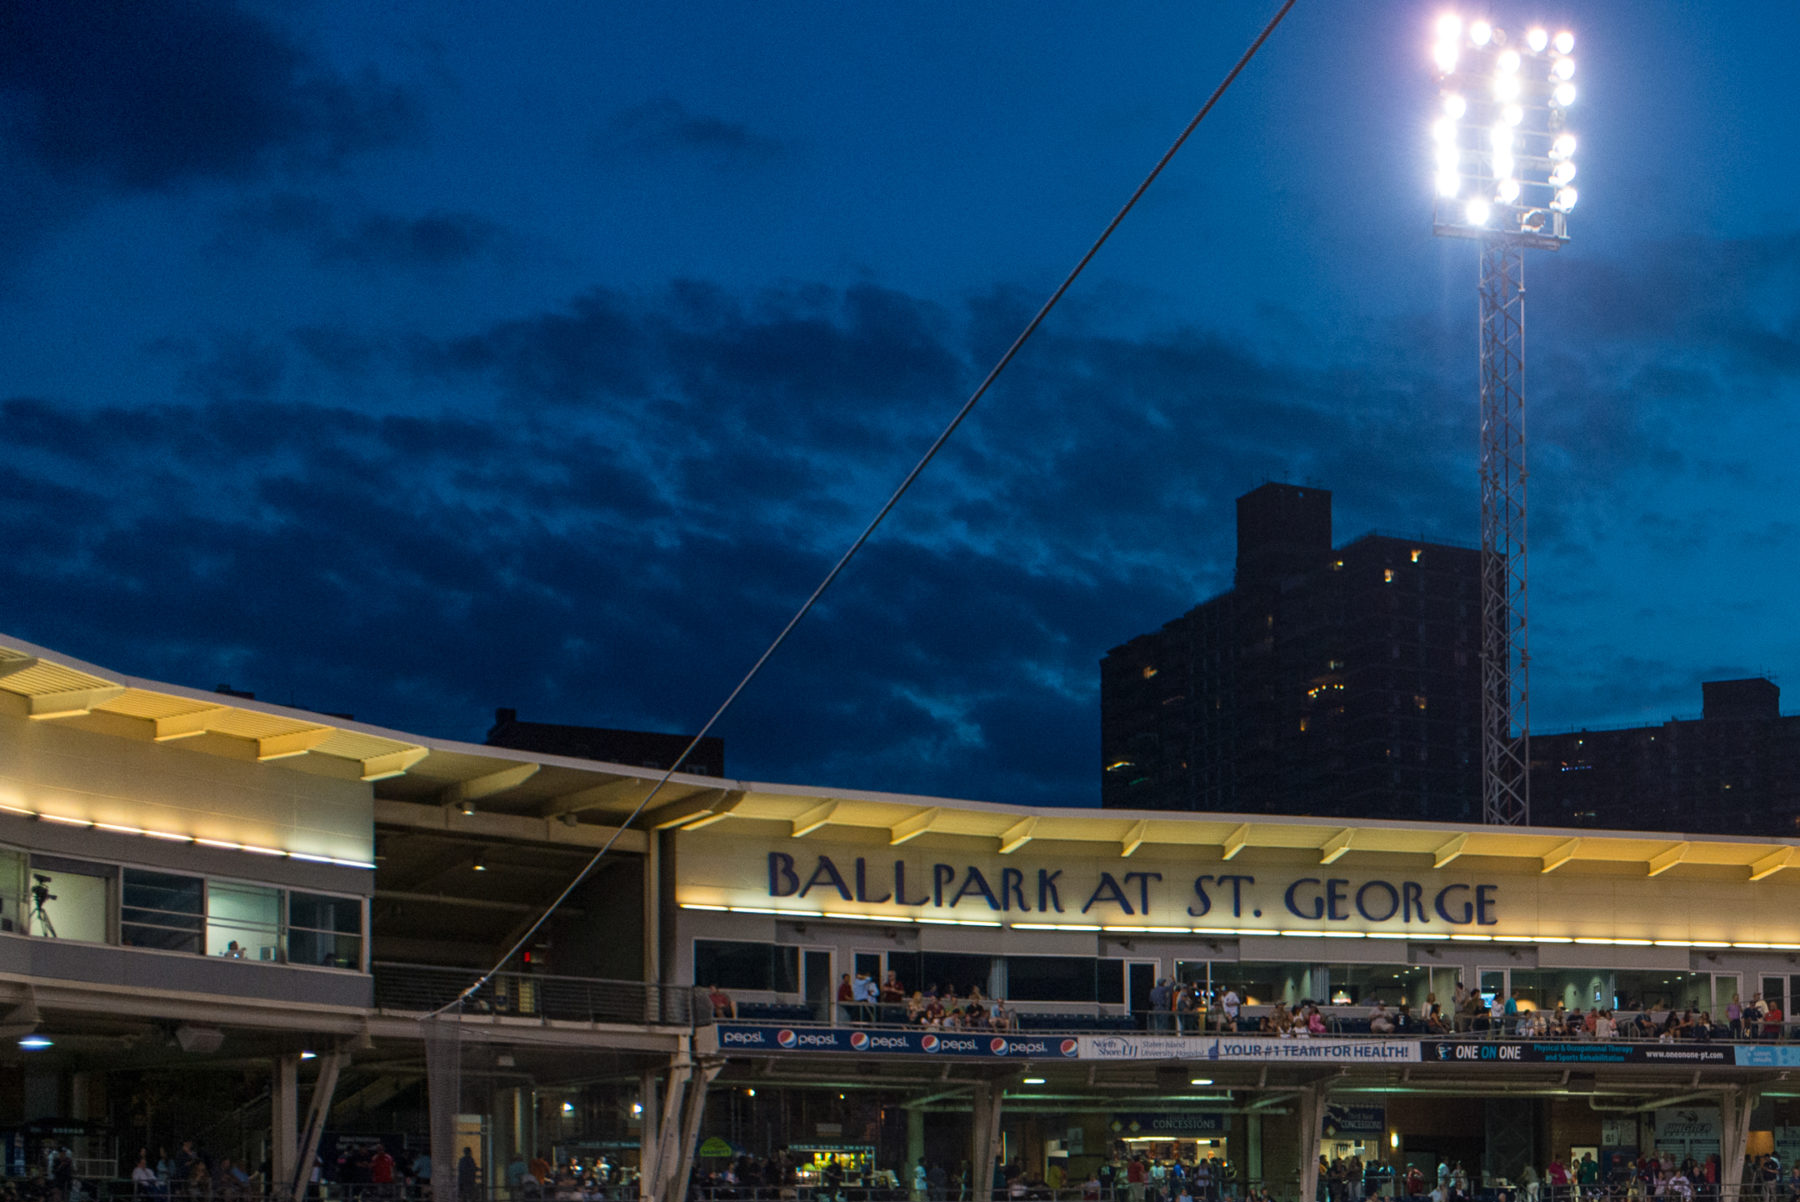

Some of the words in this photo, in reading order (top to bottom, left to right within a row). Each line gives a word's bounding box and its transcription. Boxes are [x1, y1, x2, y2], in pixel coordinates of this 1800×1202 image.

[768, 851, 1065, 913] BALLPARK
[1081, 871, 1163, 915] AT
[1186, 874, 1263, 918] ST.
[1284, 877, 1499, 925] GEORGE
[1223, 1044, 1262, 1057] YOUR
[1263, 1044, 1280, 1057] #1
[1282, 1045, 1320, 1058] TEAM
[1323, 1045, 1351, 1058] FOR
[1353, 1046, 1409, 1058] HEALTH!
[1456, 1045, 1479, 1059] ONE
[1481, 1046, 1497, 1059] ON
[1499, 1046, 1521, 1060] ONE
[1608, 1045, 1633, 1055] Therapy
[1152, 1119, 1216, 1129] CONCESSIONS
